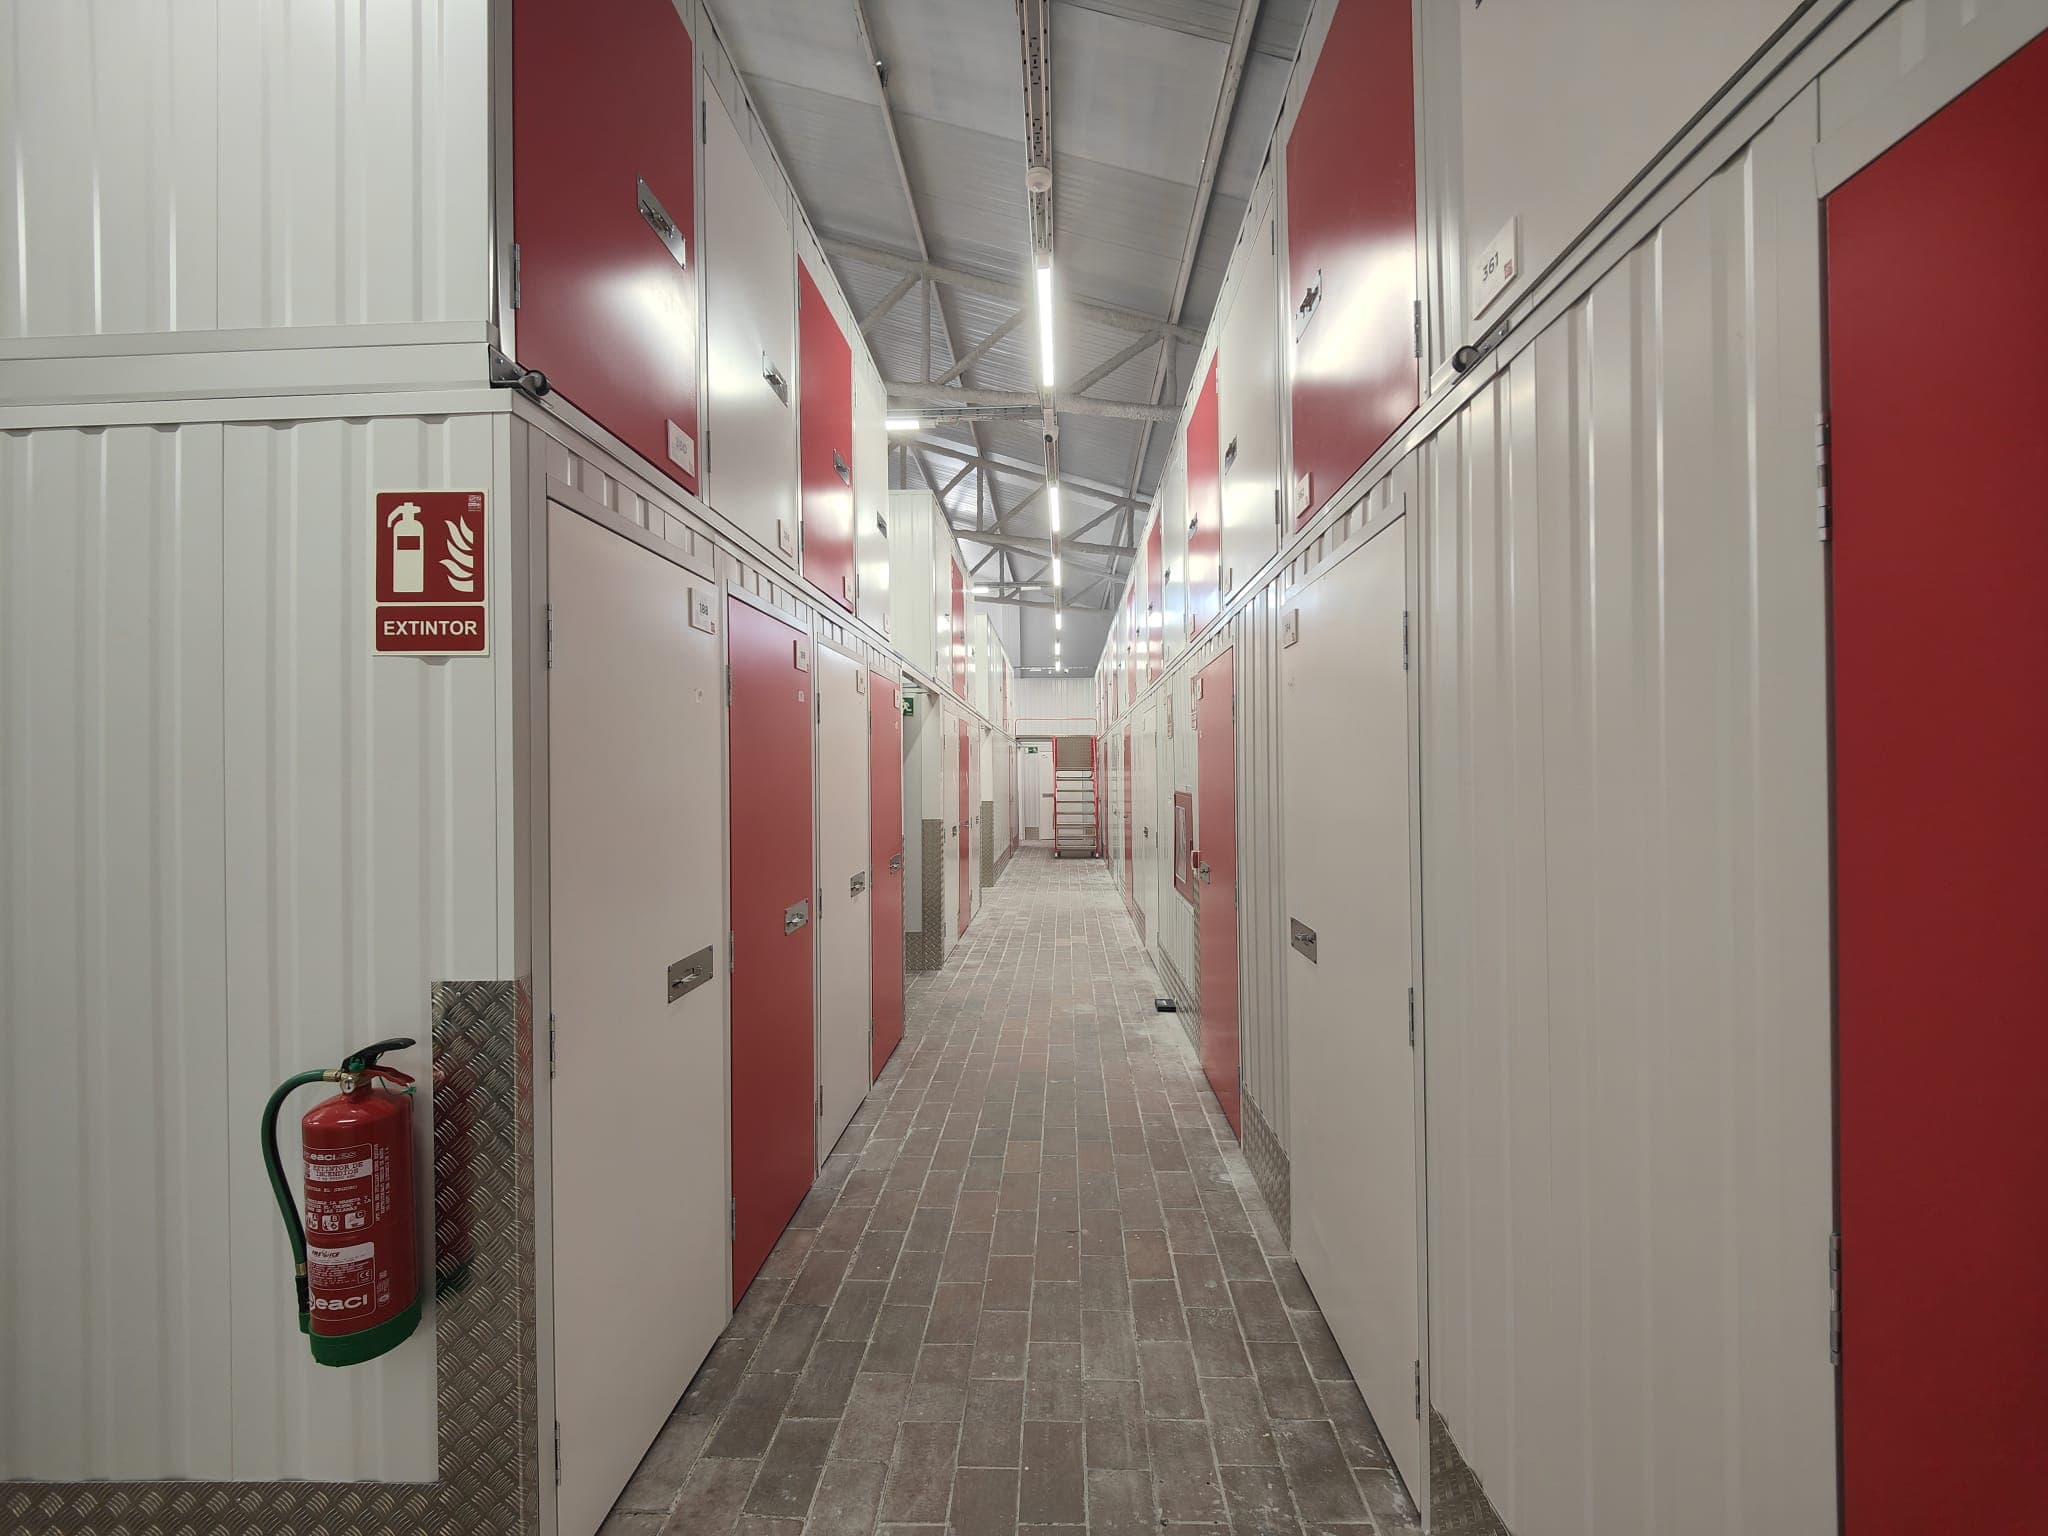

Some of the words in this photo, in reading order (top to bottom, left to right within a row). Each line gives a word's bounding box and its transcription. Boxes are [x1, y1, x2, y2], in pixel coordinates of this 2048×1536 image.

[1482, 251, 1499, 281] 361
[383, 620, 477, 636] EXTINTOR
[352, 1161, 364, 1169] DE
